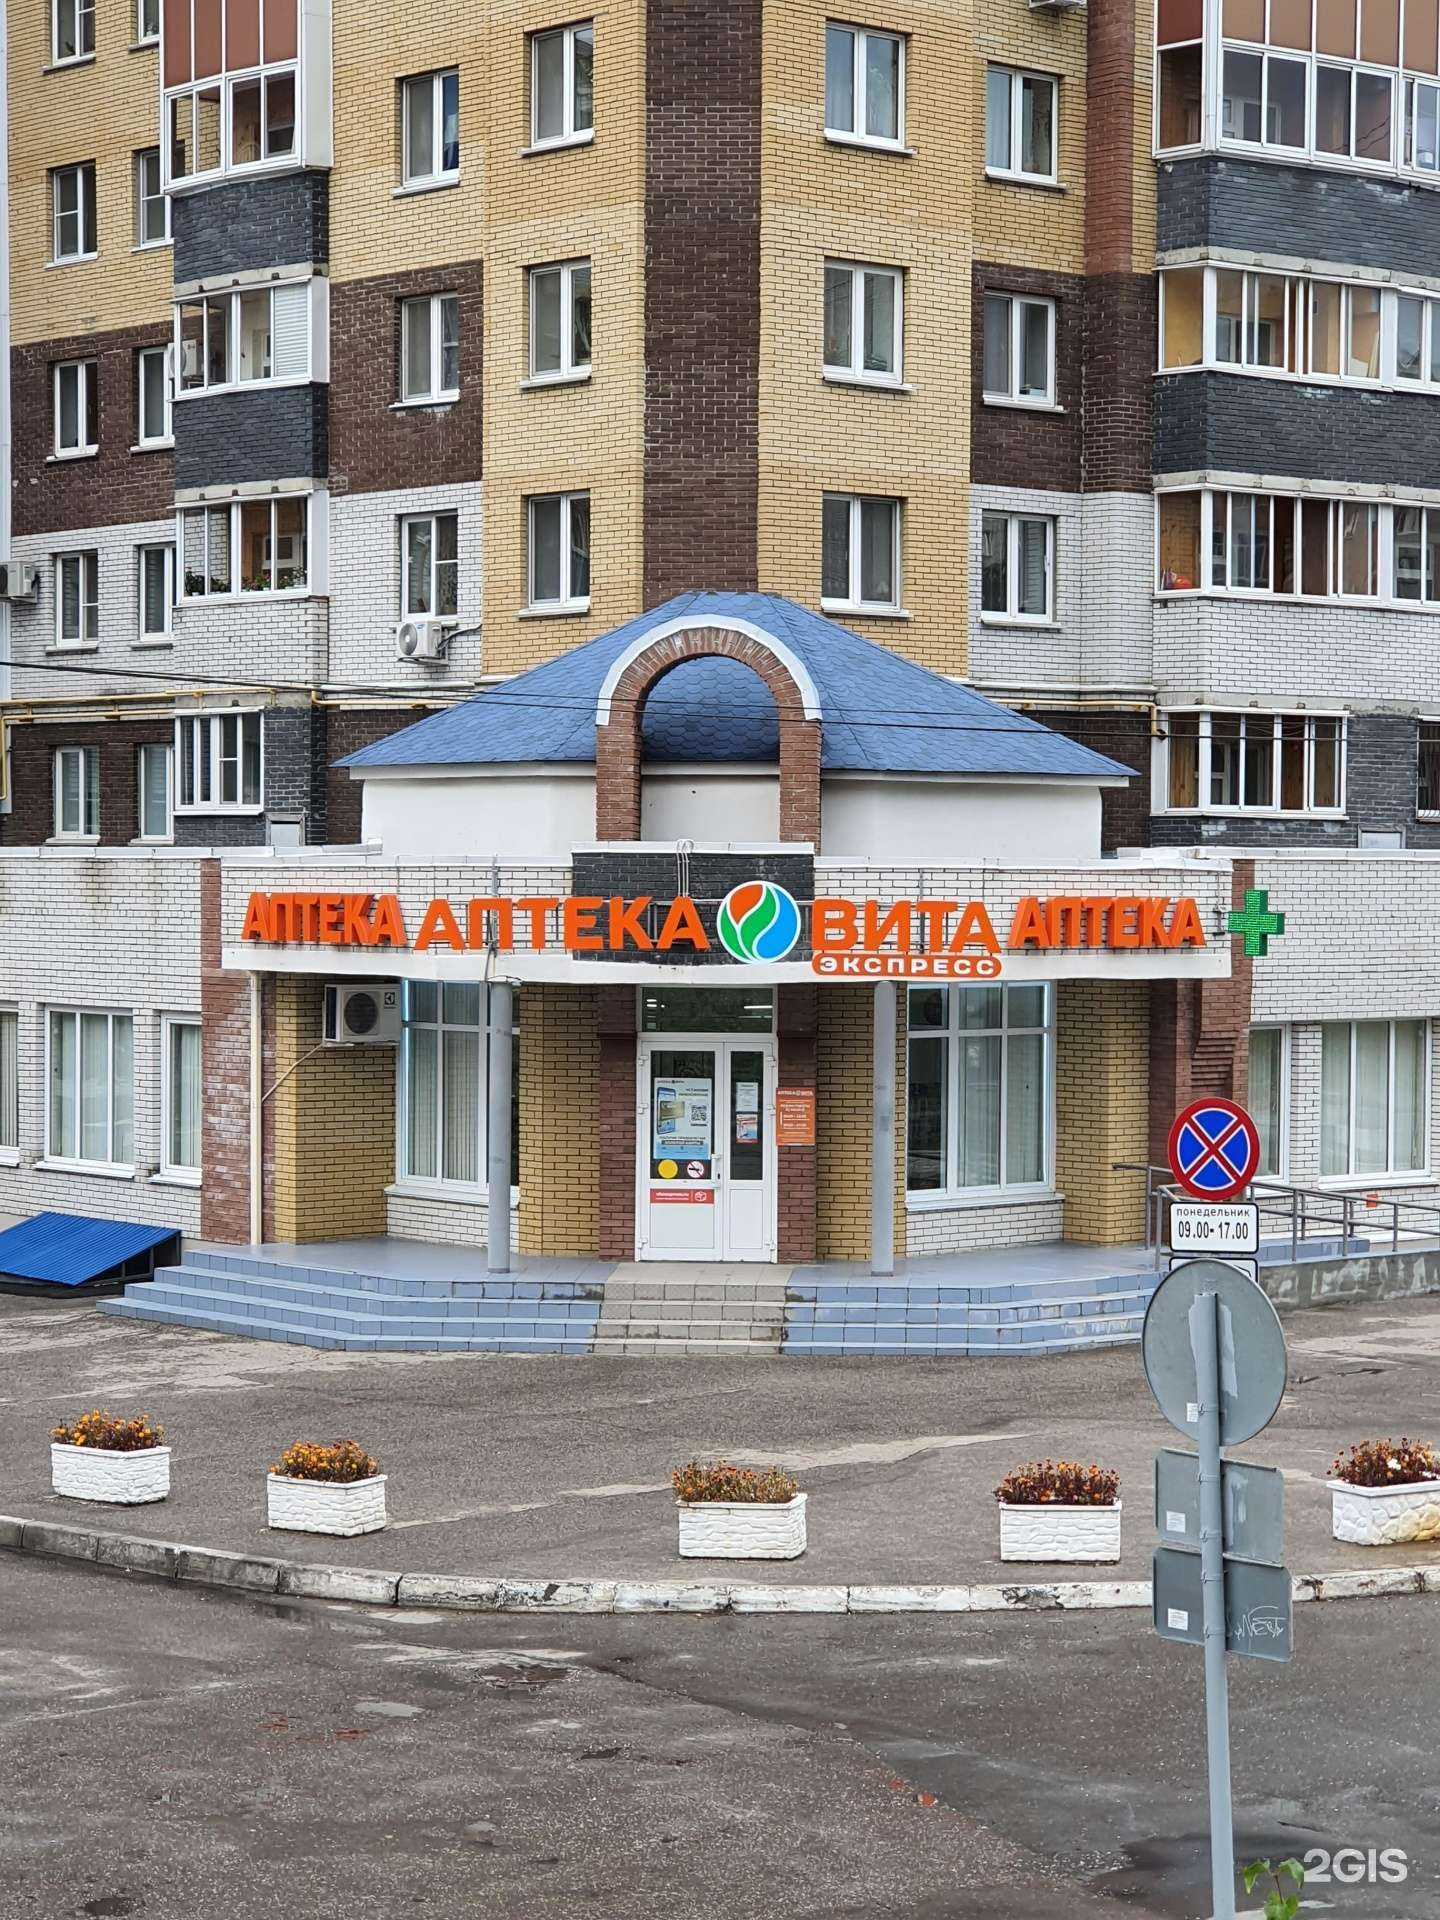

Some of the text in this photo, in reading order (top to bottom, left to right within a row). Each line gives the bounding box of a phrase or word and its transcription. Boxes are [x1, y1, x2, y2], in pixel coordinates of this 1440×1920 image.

[242, 893, 407, 947] АПТЕКА
[415, 897, 1001, 955] АПТЕКА ВИТА
[1008, 896, 1205, 949] АПТЕКА
[820, 955, 996, 976] ЭКСПРЕСС
[1176, 1207, 1251, 1218] понедельник
